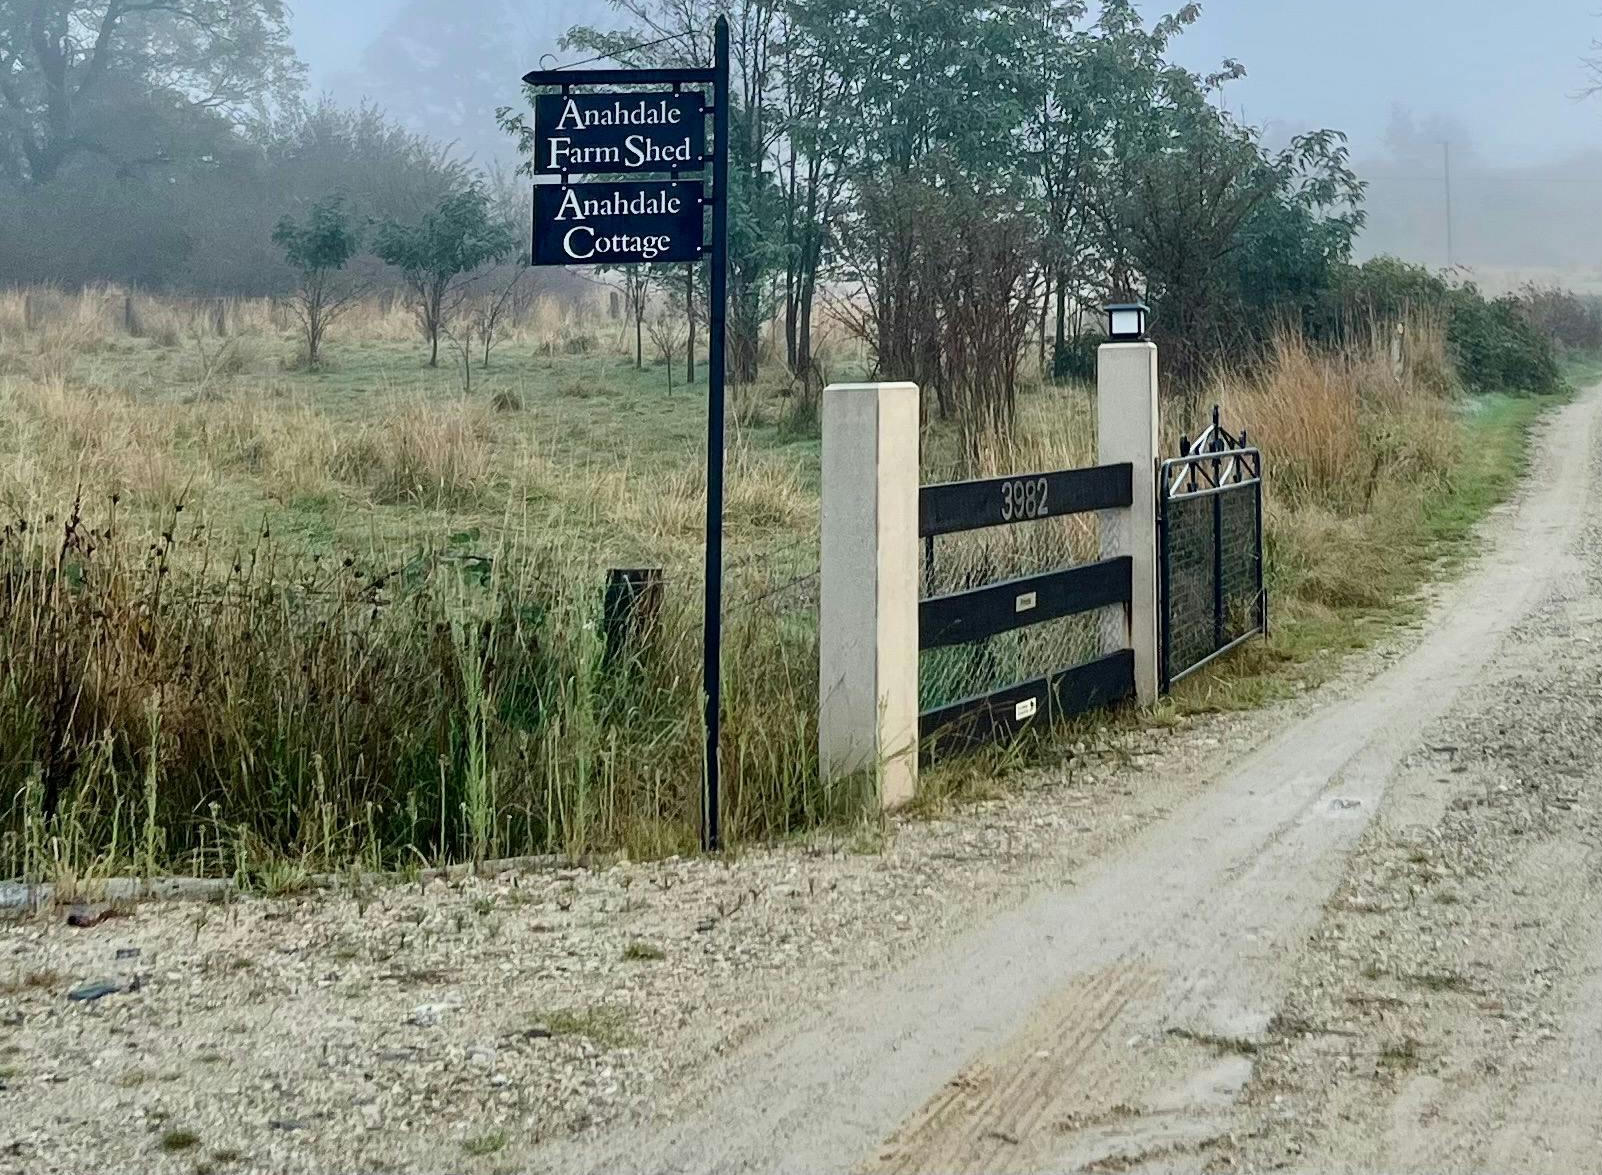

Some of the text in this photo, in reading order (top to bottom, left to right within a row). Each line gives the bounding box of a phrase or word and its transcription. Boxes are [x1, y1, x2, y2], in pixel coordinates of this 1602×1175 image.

[555, 99, 681, 130] Anahdale
[547, 135, 691, 169] Farm Shed
[554, 188, 681, 221] Anahdale
[563, 226, 671, 259] Cottage
[1002, 478, 1048, 520] 3982
